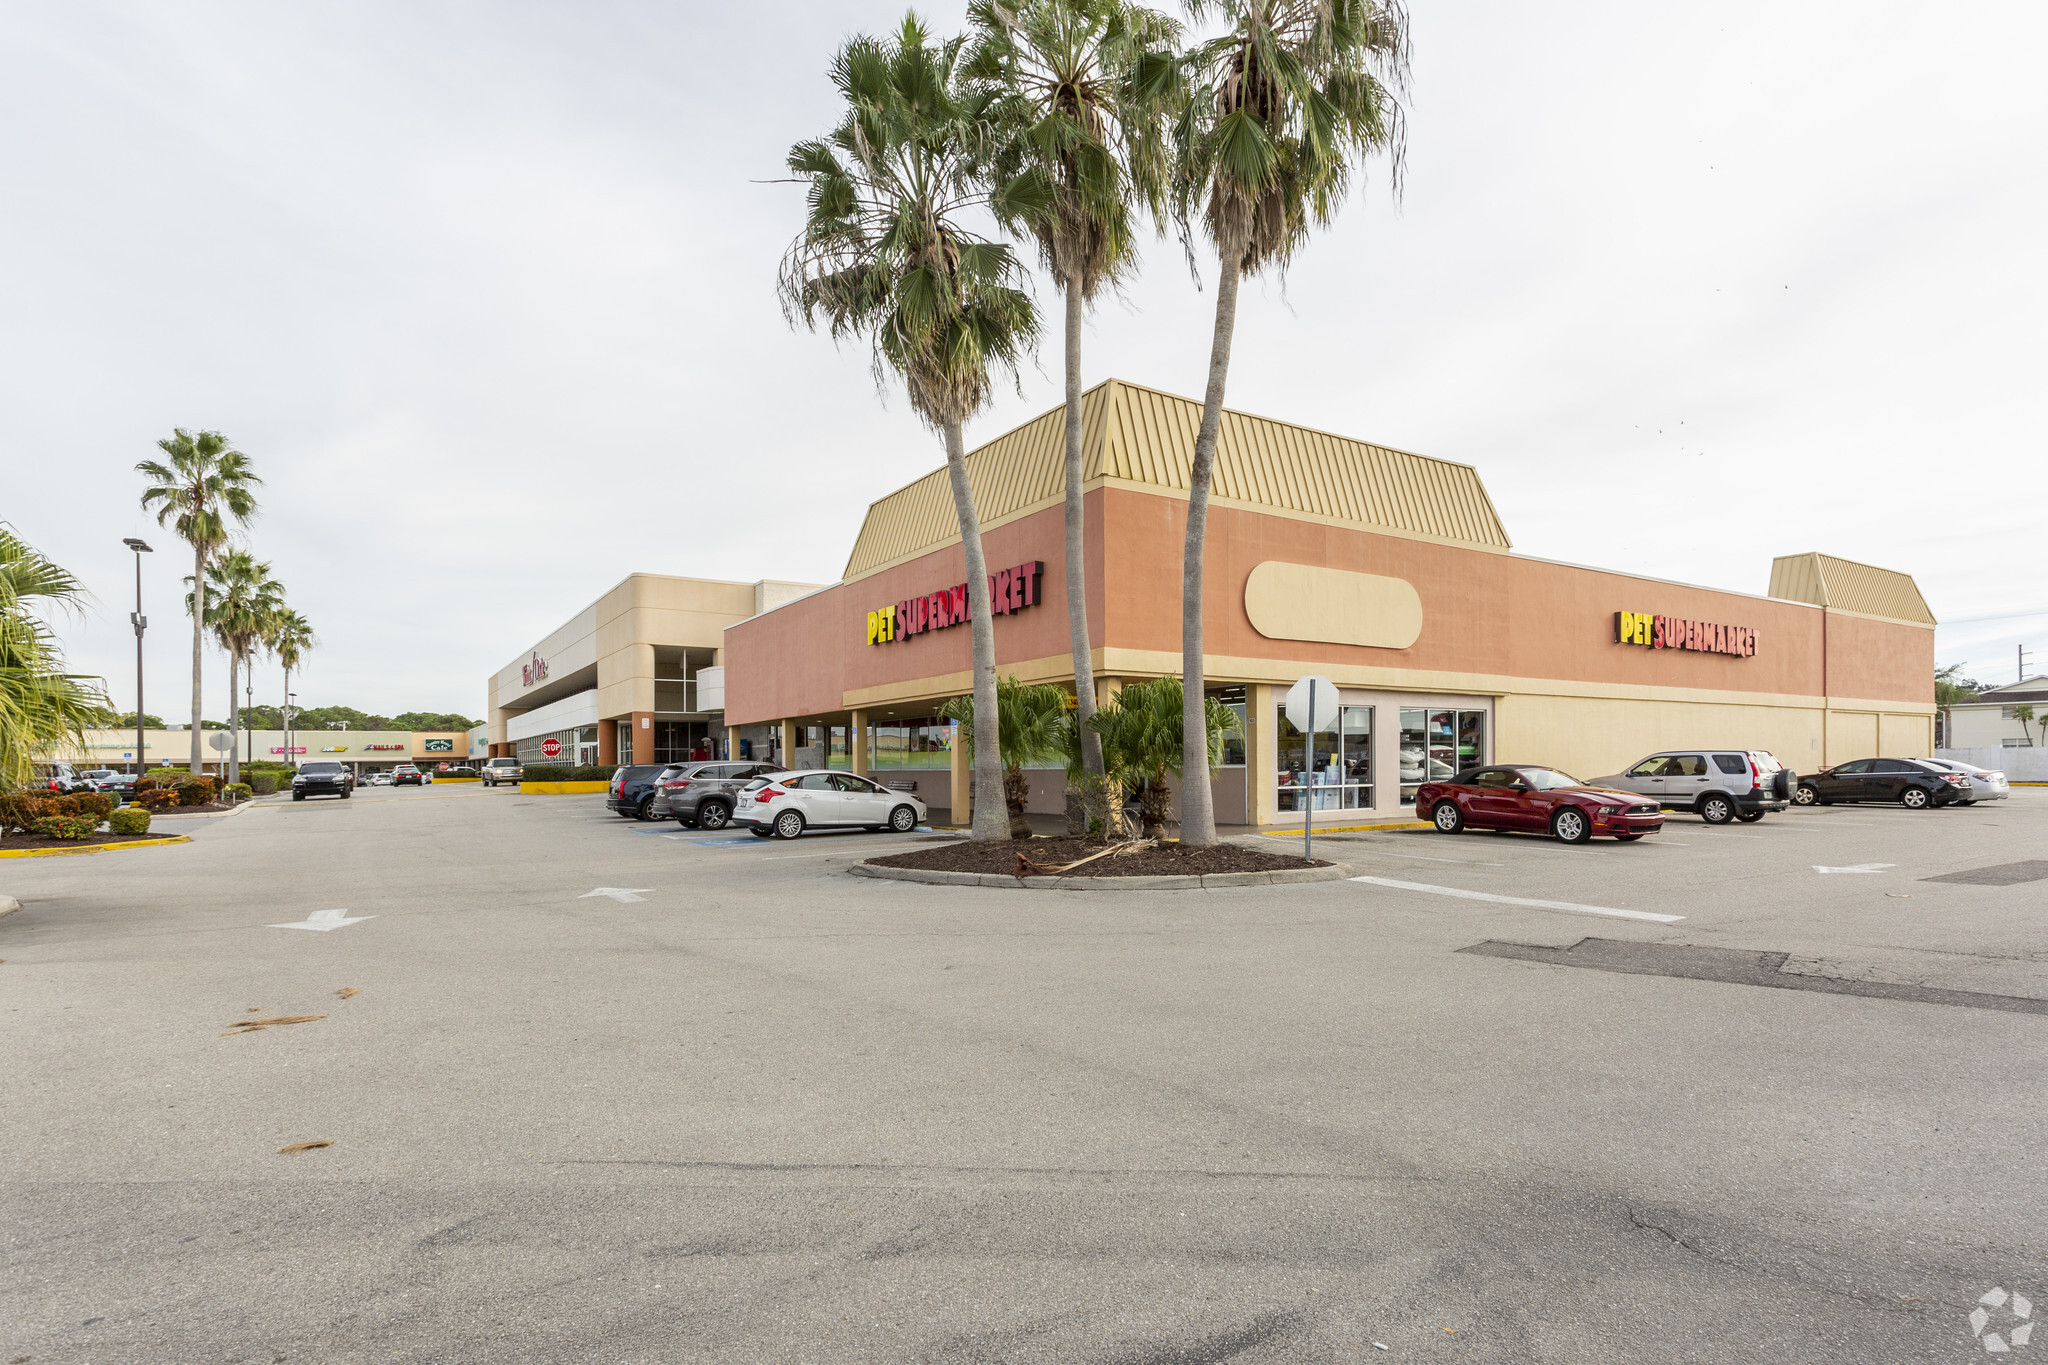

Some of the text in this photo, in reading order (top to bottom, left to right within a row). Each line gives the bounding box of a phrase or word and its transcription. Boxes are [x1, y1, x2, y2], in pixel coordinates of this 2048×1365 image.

[867, 604, 896, 646] PET
[1620, 610, 1761, 658] PET SUPERMARKET
[542, 743, 561, 752] STOP
